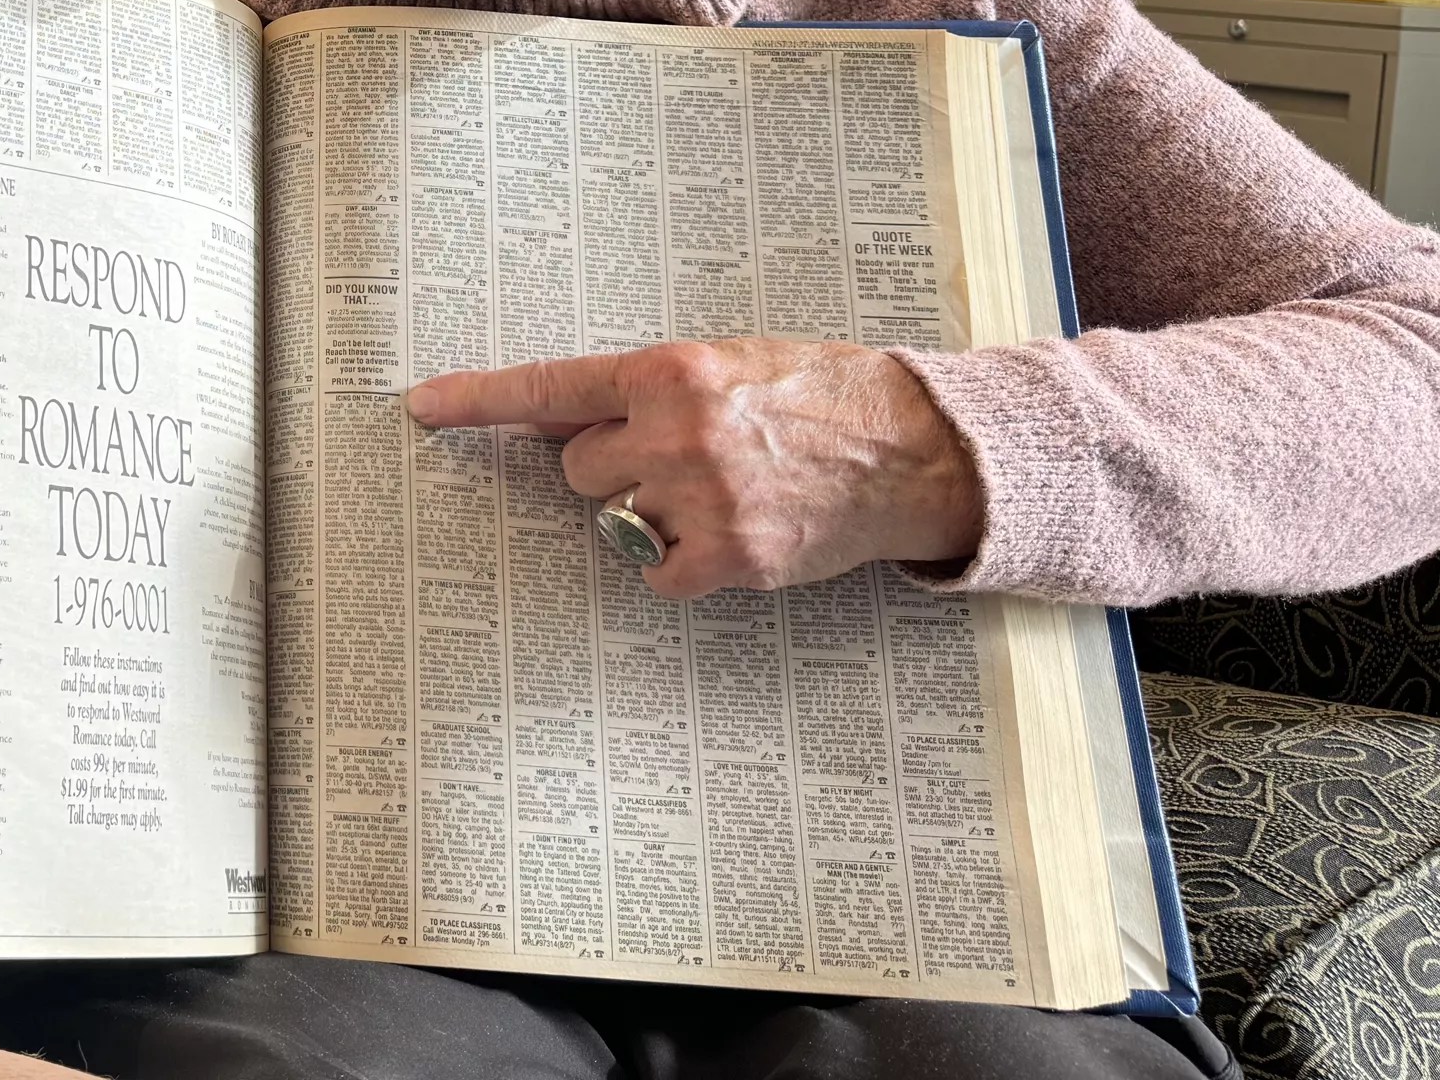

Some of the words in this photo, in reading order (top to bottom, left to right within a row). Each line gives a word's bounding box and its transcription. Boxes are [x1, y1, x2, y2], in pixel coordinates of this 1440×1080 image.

[872, 231, 912, 242] QUOTE
[898, 245, 932, 255] WEEK
[855, 259, 883, 268] Nobody
[886, 260, 899, 268] will
[869, 267, 890, 276] battle
[24, 235, 186, 323] RESPOND
[888, 276, 917, 284] There's
[368, 284, 397, 294] KNOW
[857, 285, 878, 293] much
[894, 285, 936, 294] fraternizing
[332, 339, 351, 348] Don't
[348, 348, 367, 357] these
[88, 324, 139, 394] TO
[365, 358, 398, 366] advertise
[331, 377, 356, 385] PRIYA,
[358, 378, 391, 386] 296-8661
[18, 395, 195, 486] ROMANCE
[449, 485, 476, 493] REDHEAD
[48, 484, 171, 567] TODAY
[53, 575, 170, 634] 1-976-0001
[464, 631, 491, 639] SPIRITED
[63, 647, 91, 666] Follow
[93, 649, 114, 668] these
[117, 653, 162, 672] instructions
[60, 674, 76, 691] and
[78, 674, 95, 696] find
[114, 676, 130, 695] how
[132, 685, 149, 701] easy
[151, 681, 156, 697] it
[159, 681, 165, 698] is
[67, 703, 75, 717] to
[77, 701, 109, 723] respond
[112, 706, 119, 720] to
[122, 702, 160, 723] Westword
[73, 725, 111, 745] Romance
[114, 728, 137, 751] today.
[140, 729, 156, 748] Call
[916, 736, 936, 744] PLACE
[339, 749, 366, 757] BOULDER
[70, 757, 90, 770] costs
[112, 757, 125, 777] per
[128, 757, 158, 776] minute,
[60, 778, 87, 798] $1.99
[89, 778, 101, 801] for
[103, 779, 116, 798] the
[118, 779, 135, 803] first
[137, 783, 167, 800] minute.
[67, 804, 84, 823] Toll
[86, 805, 118, 829] charges
[120, 814, 137, 830] may
[139, 808, 162, 831] apply.
[439, 919, 459, 927] PLACE
[460, 921, 500, 930] CLASSIFIEDS
[422, 927, 433, 936] Call
[436, 928, 466, 937] Westword
[452, 937, 475, 946] Monday
